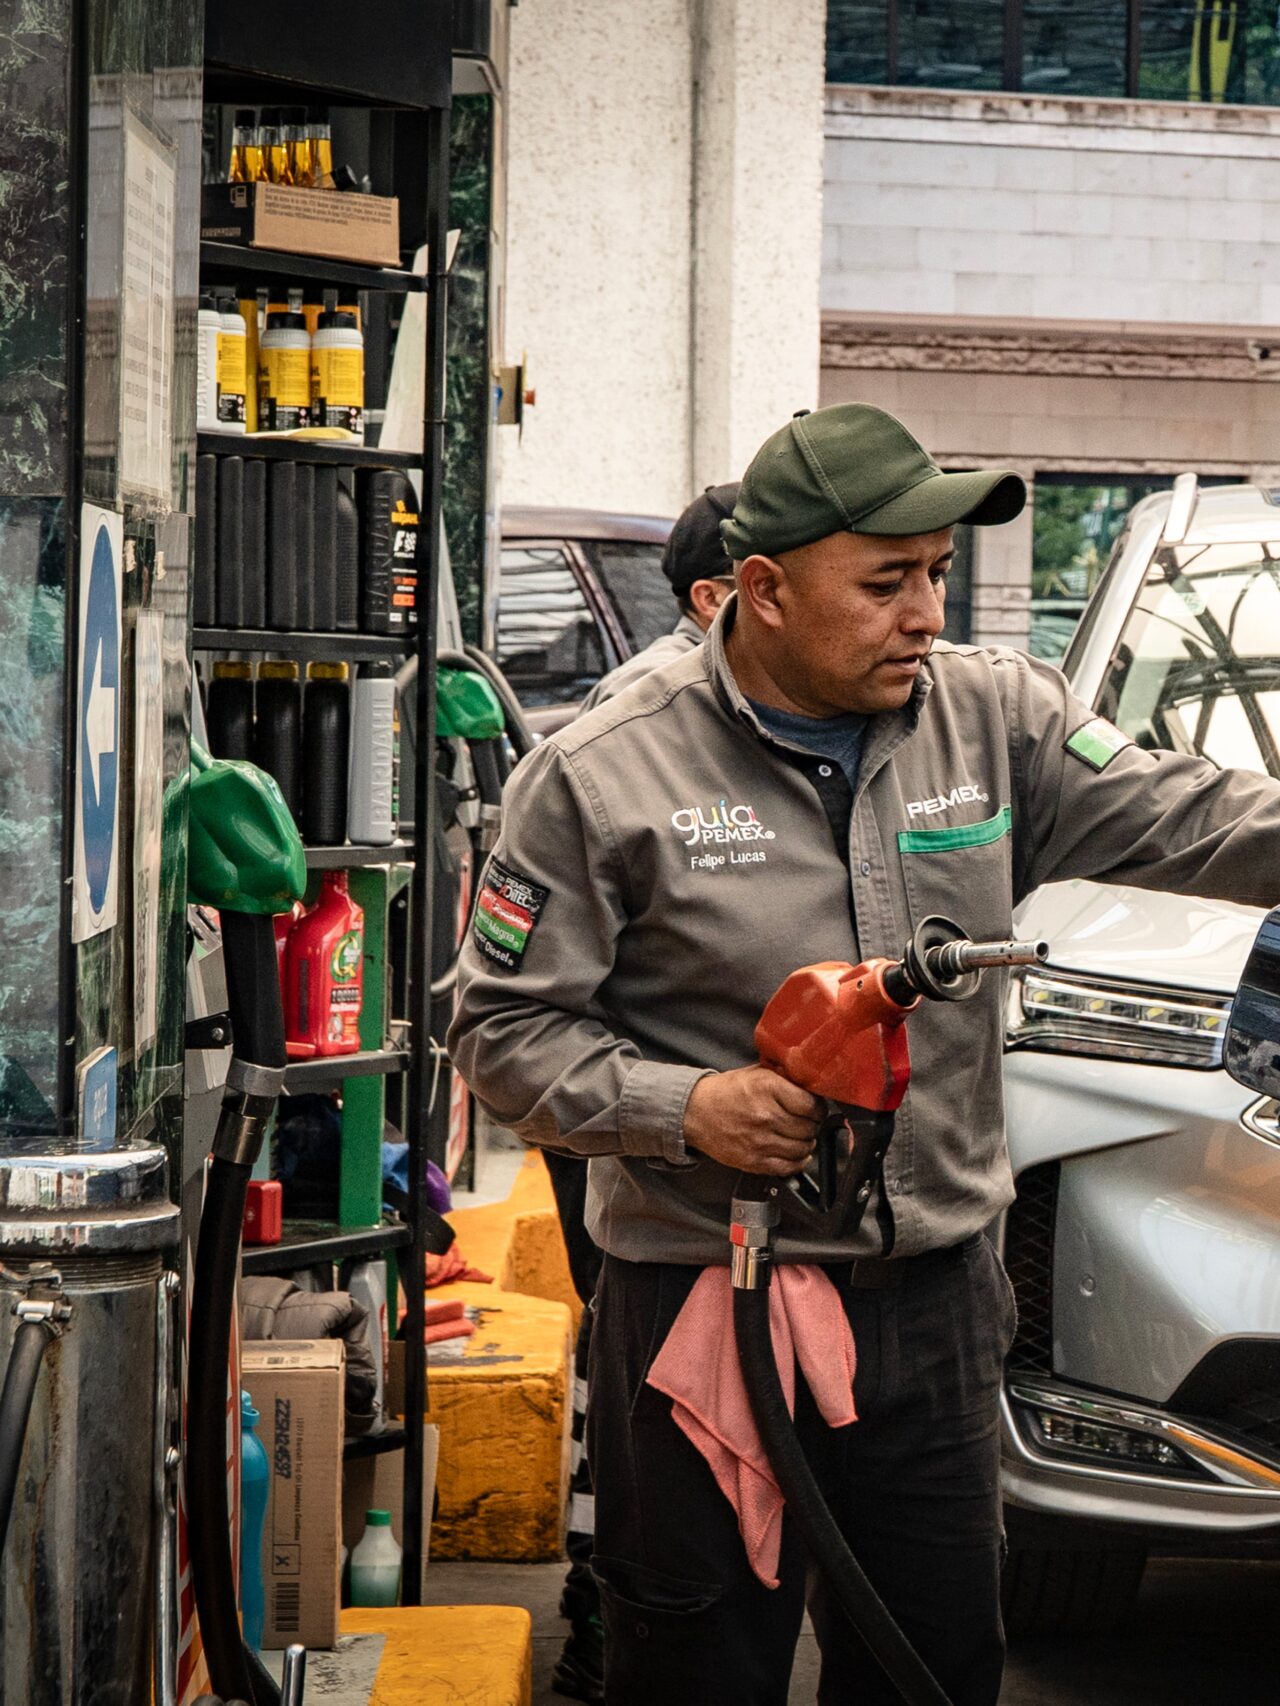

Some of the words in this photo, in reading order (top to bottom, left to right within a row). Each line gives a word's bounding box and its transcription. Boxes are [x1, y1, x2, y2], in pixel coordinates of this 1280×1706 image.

[371, 697, 391, 826] BARDAHL
[906, 785, 983, 819] PEMEX
[701, 827, 766, 844] PEMEX
[691, 855, 726, 870] Felipe
[730, 851, 766, 864] Lucas
[488, 922, 515, 942] Magna
[484, 942, 510, 962] Diesel
